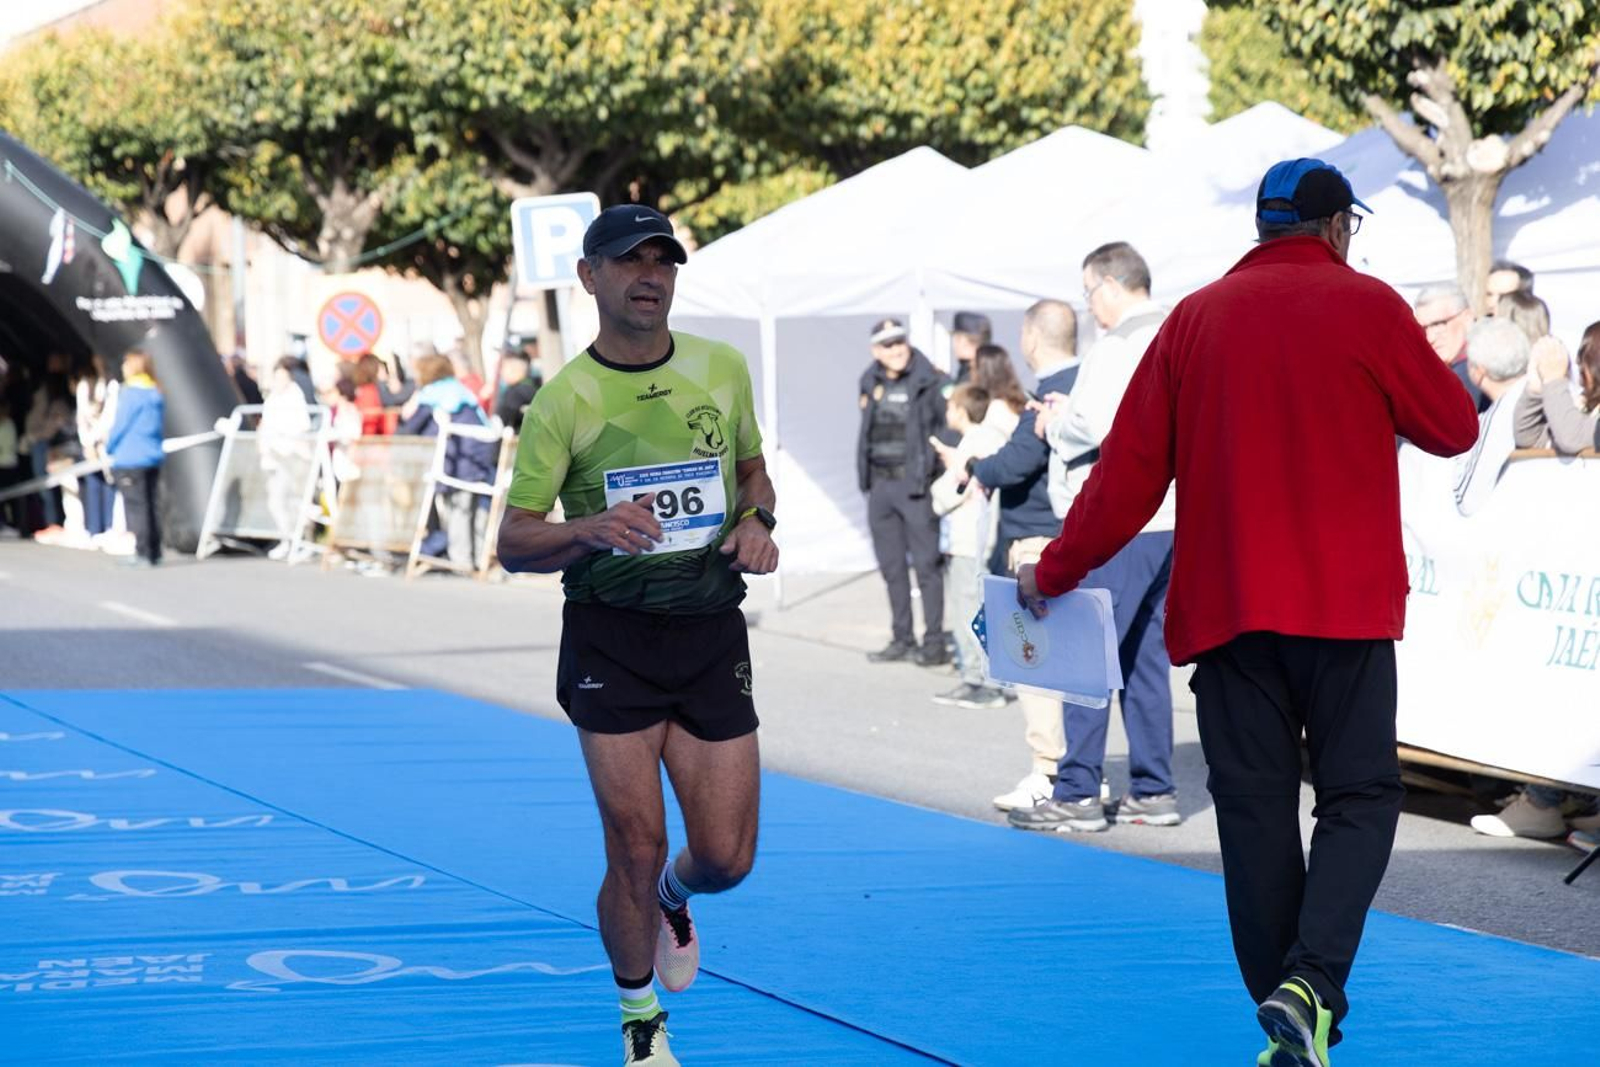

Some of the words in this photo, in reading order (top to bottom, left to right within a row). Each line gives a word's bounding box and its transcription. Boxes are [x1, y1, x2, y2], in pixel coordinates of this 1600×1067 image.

[530, 207, 584, 278] P
[0, 964, 204, 981] MARA
[0, 974, 203, 992] MEDI
